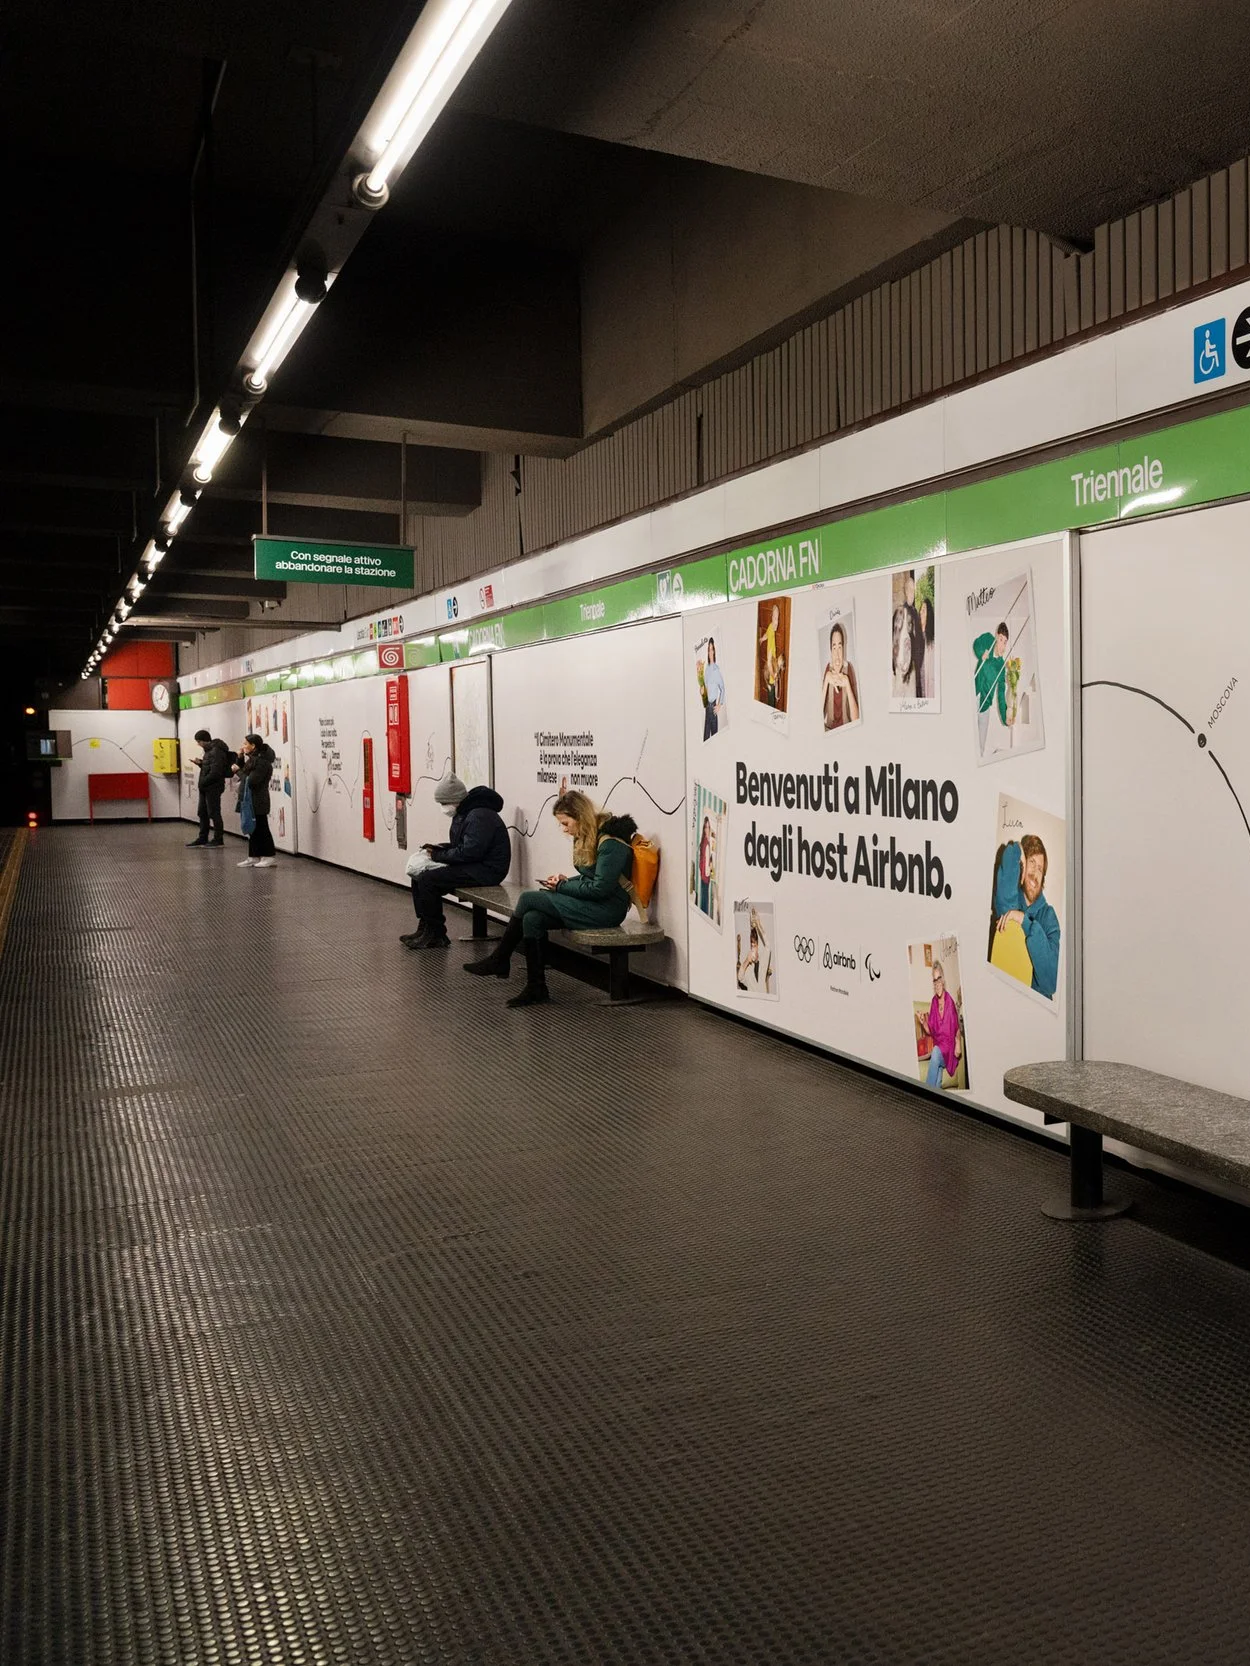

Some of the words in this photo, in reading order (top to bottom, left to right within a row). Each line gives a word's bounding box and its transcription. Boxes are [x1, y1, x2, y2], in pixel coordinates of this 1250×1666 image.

[1071, 455, 1163, 507] Triennale
[275, 560, 343, 574] abbandonare
[344, 565, 353, 575] la
[354, 565, 396, 578] stazione
[290, 550, 311, 561] Con
[313, 551, 353, 564] segnale
[353, 556, 382, 567] attivo
[728, 545, 797, 595] CADORNA
[799, 537, 820, 578] FN
[1207, 677, 1239, 729] MOSCOVA
[735, 760, 840, 811] Benvenuti
[844, 779, 859, 814] a
[865, 764, 959, 824] Milano
[744, 821, 793, 883] dagli
[797, 829, 848, 884] host
[852, 835, 952, 900] Airbnb.
[833, 951, 857, 971] airbnb
